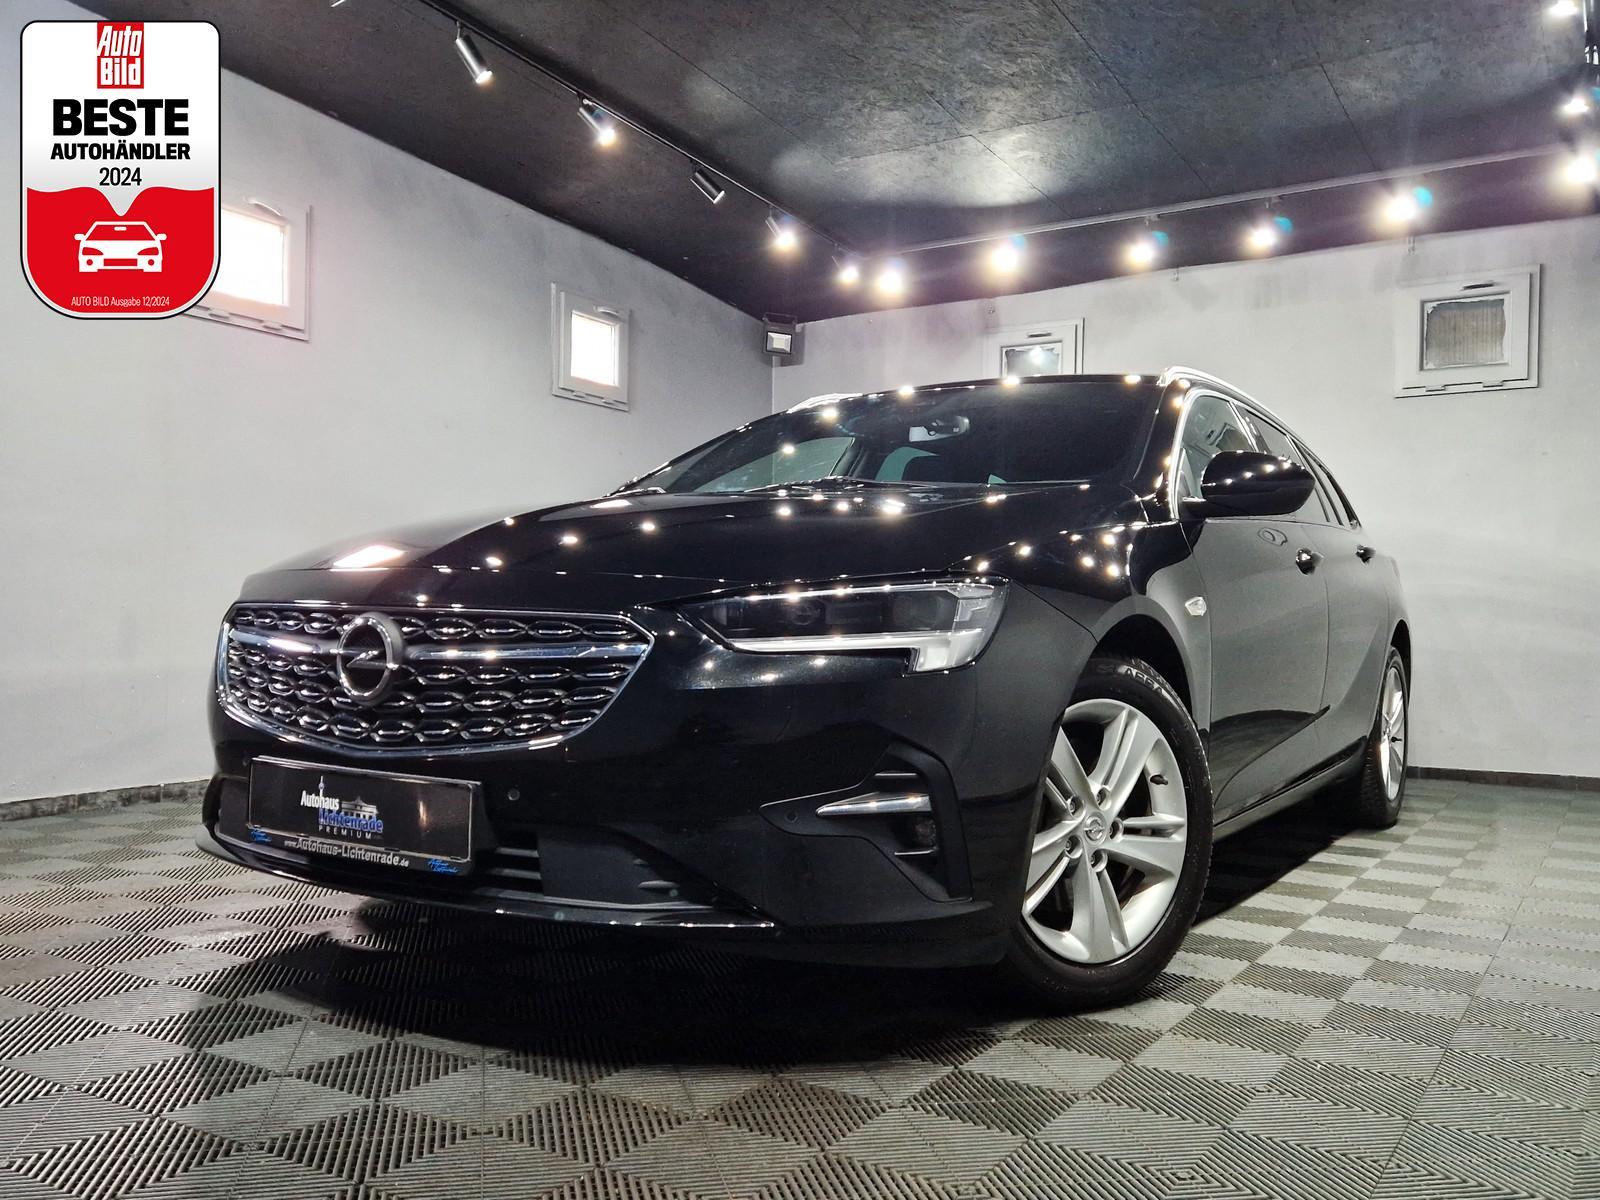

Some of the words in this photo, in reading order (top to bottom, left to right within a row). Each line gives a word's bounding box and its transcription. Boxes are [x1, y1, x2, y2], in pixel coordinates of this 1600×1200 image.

[300, 790, 340, 811] Autohaus
[319, 808, 384, 834] Lichtenrade
[319, 825, 372, 840] PREMIUM
